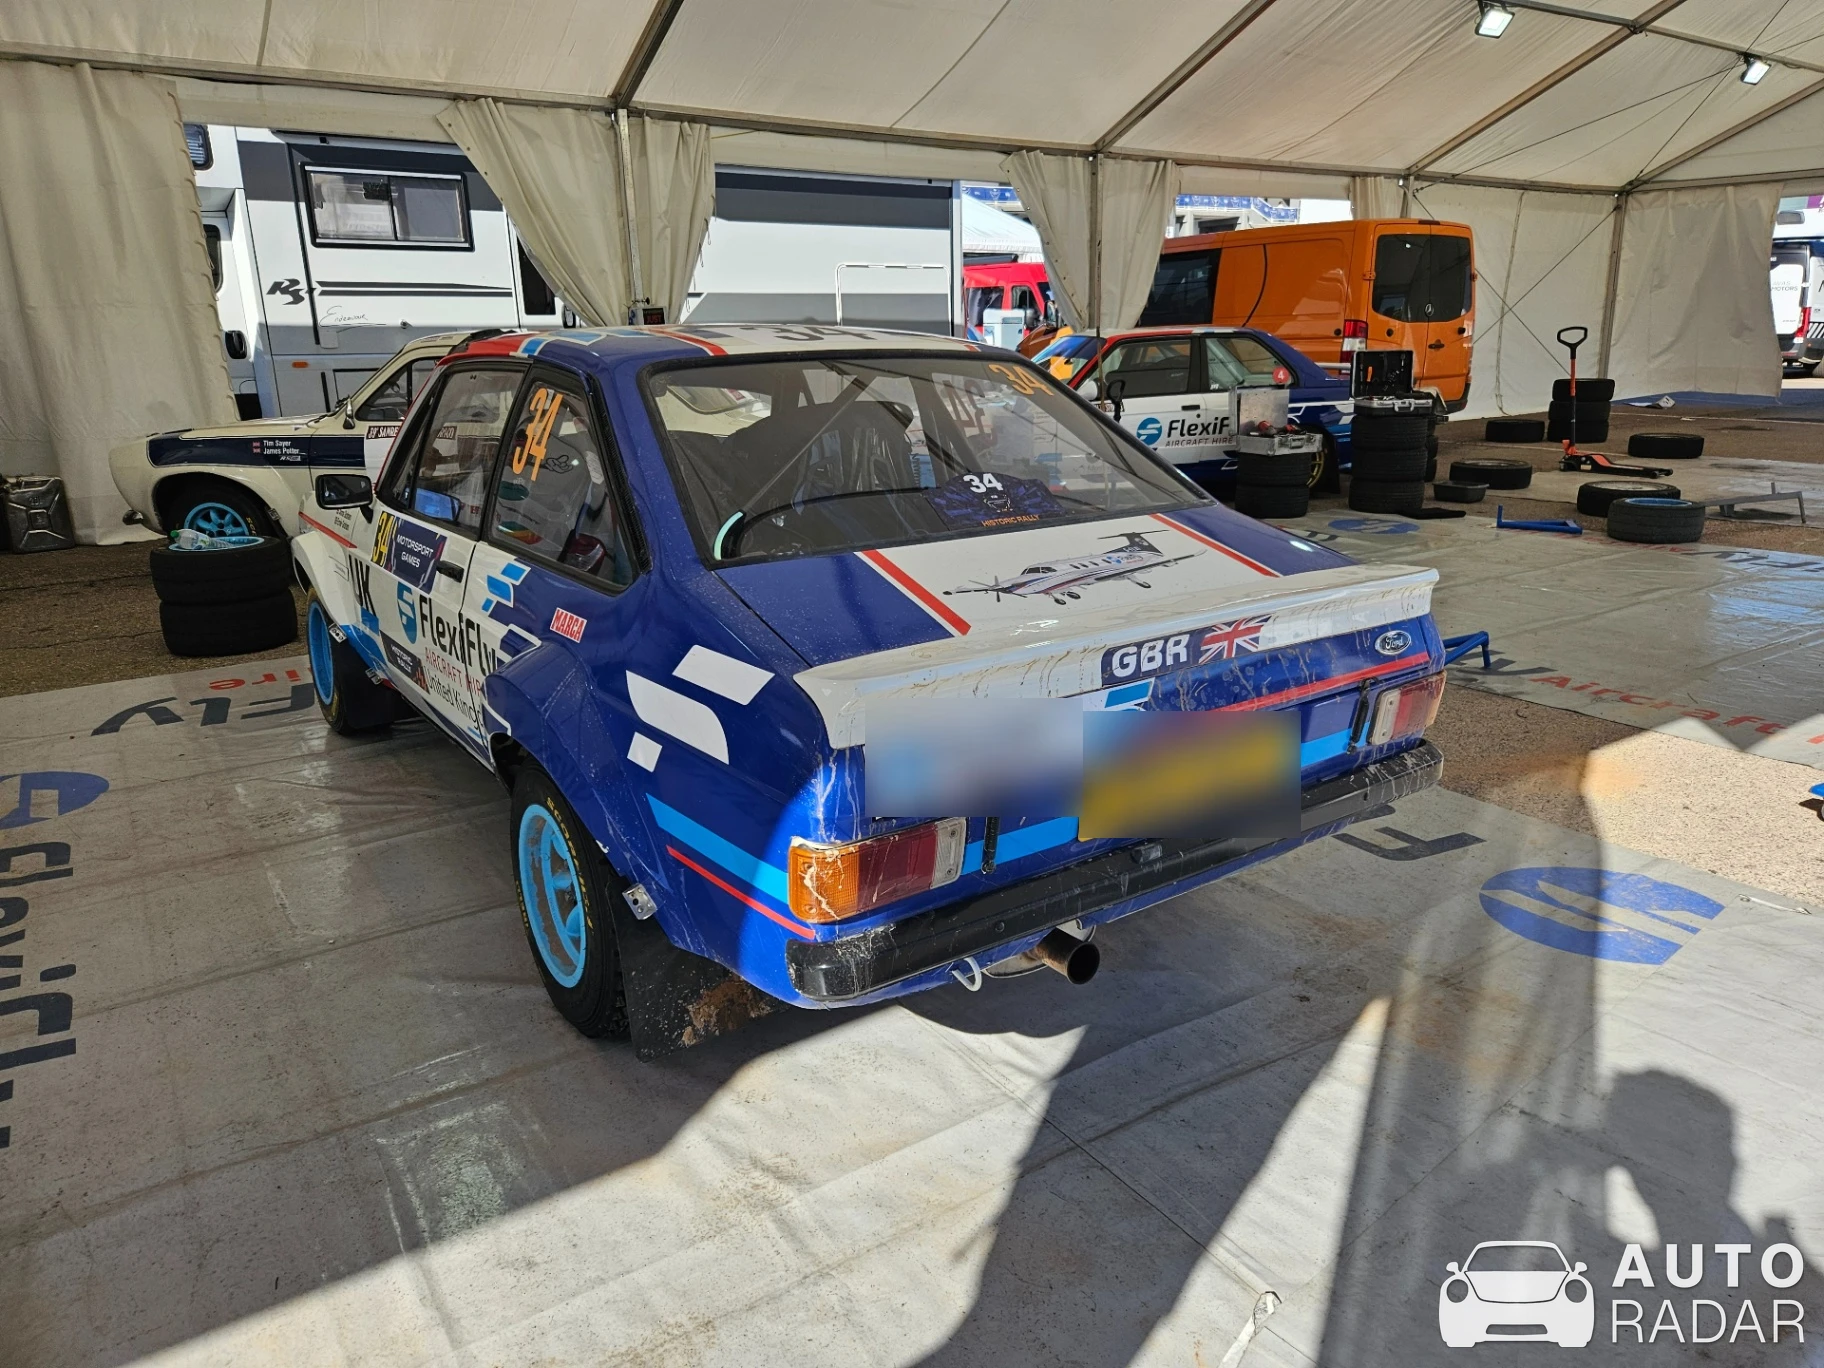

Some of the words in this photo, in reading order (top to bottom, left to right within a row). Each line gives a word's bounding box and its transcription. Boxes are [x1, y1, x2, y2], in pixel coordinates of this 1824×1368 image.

[985, 364, 1055, 396] 34
[512, 387, 564, 482] 34
[1167, 416, 1230, 438] FlexiF
[263, 447, 281, 455] James
[275, 440, 292, 448] Sayer
[1165, 437, 1210, 447] AIRCRAFT
[1211, 436, 1234, 445] HIRE
[963, 473, 1003, 494] 34
[981, 516, 1017, 527] HISTORIC
[1017, 514, 1040, 524] RALLY
[371, 511, 394, 567] 34
[396, 534, 434, 559] MOTORSPORT
[401, 551, 421, 568] GAMES
[348, 554, 378, 618] UK
[552, 609, 586, 642] MARCA
[1111, 633, 1190, 678] GBR
[209, 669, 304, 691] ire
[425, 646, 463, 688] AIRCRAFT
[464, 673, 482, 697] HIR
[1528, 675, 1790, 735] Aircraft
